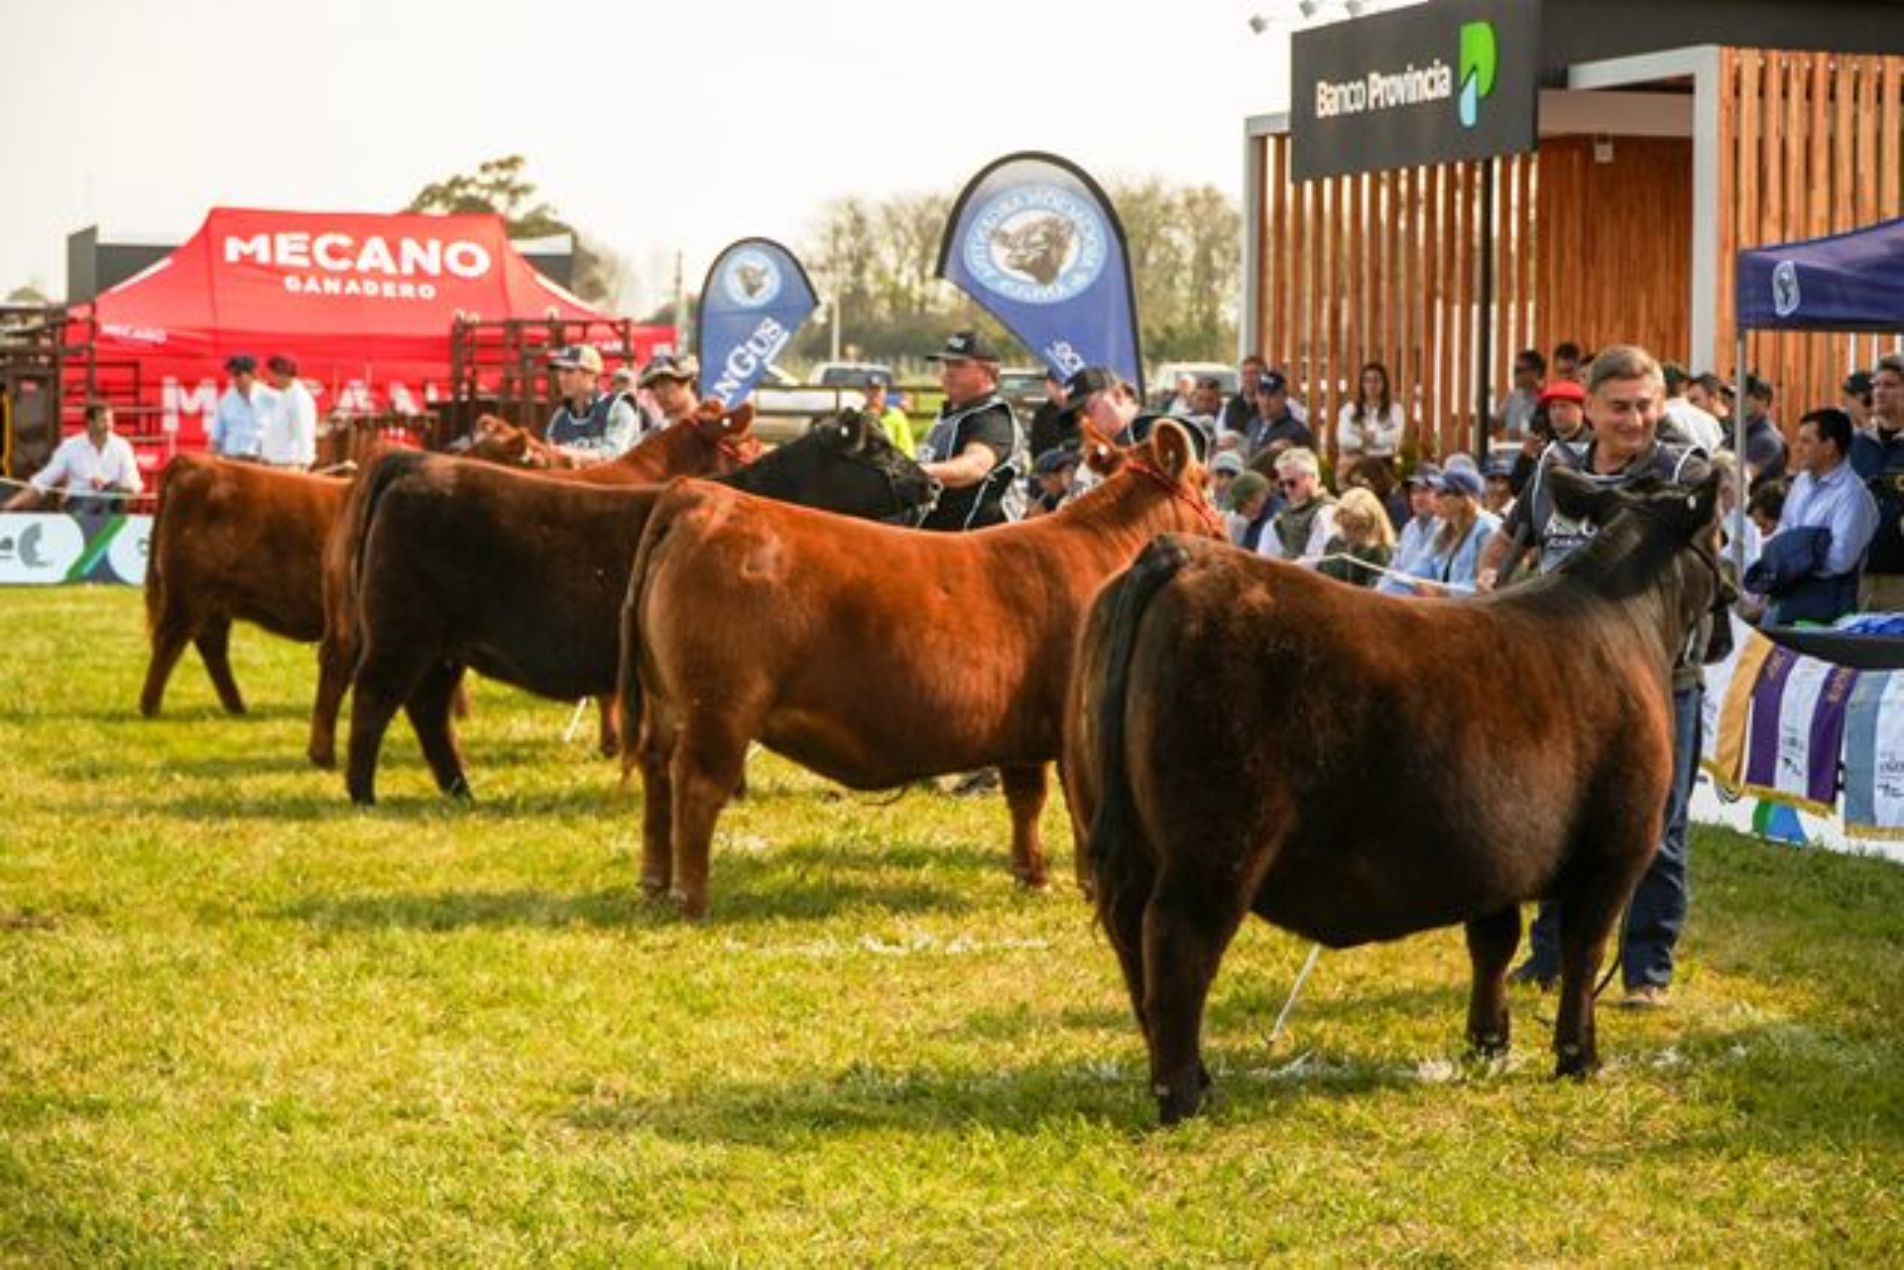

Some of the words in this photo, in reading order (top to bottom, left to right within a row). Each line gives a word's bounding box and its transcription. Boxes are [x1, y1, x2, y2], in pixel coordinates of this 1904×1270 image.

[1316, 78, 1367, 119] Banco
[1368, 57, 1452, 110] Provincia
[224, 232, 491, 278] MECANO
[283, 274, 436, 300] GANADERO
[713, 316, 782, 404] NGUS
